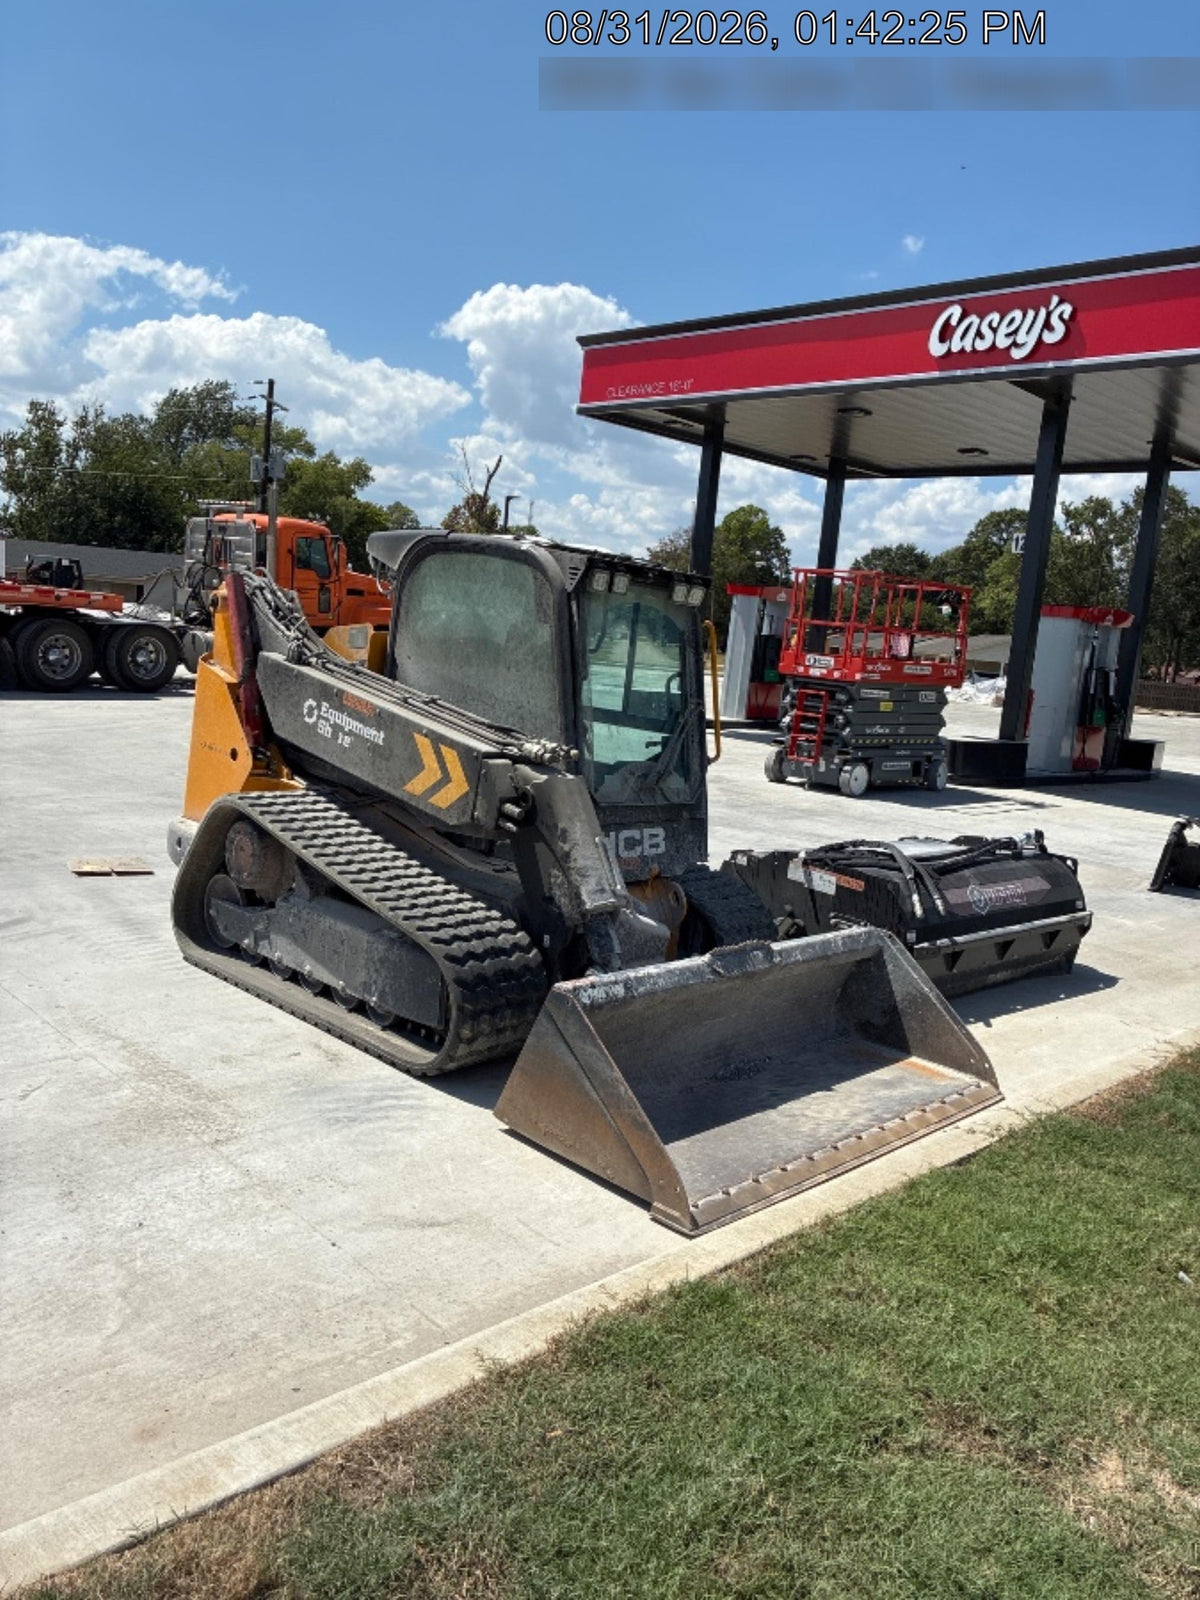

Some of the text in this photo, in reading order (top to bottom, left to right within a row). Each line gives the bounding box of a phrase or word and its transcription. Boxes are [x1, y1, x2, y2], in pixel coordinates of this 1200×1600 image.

[928, 294, 1073, 360] Casey's
[607, 381, 666, 398] CLEARANCE
[320, 701, 385, 746] Equipment
